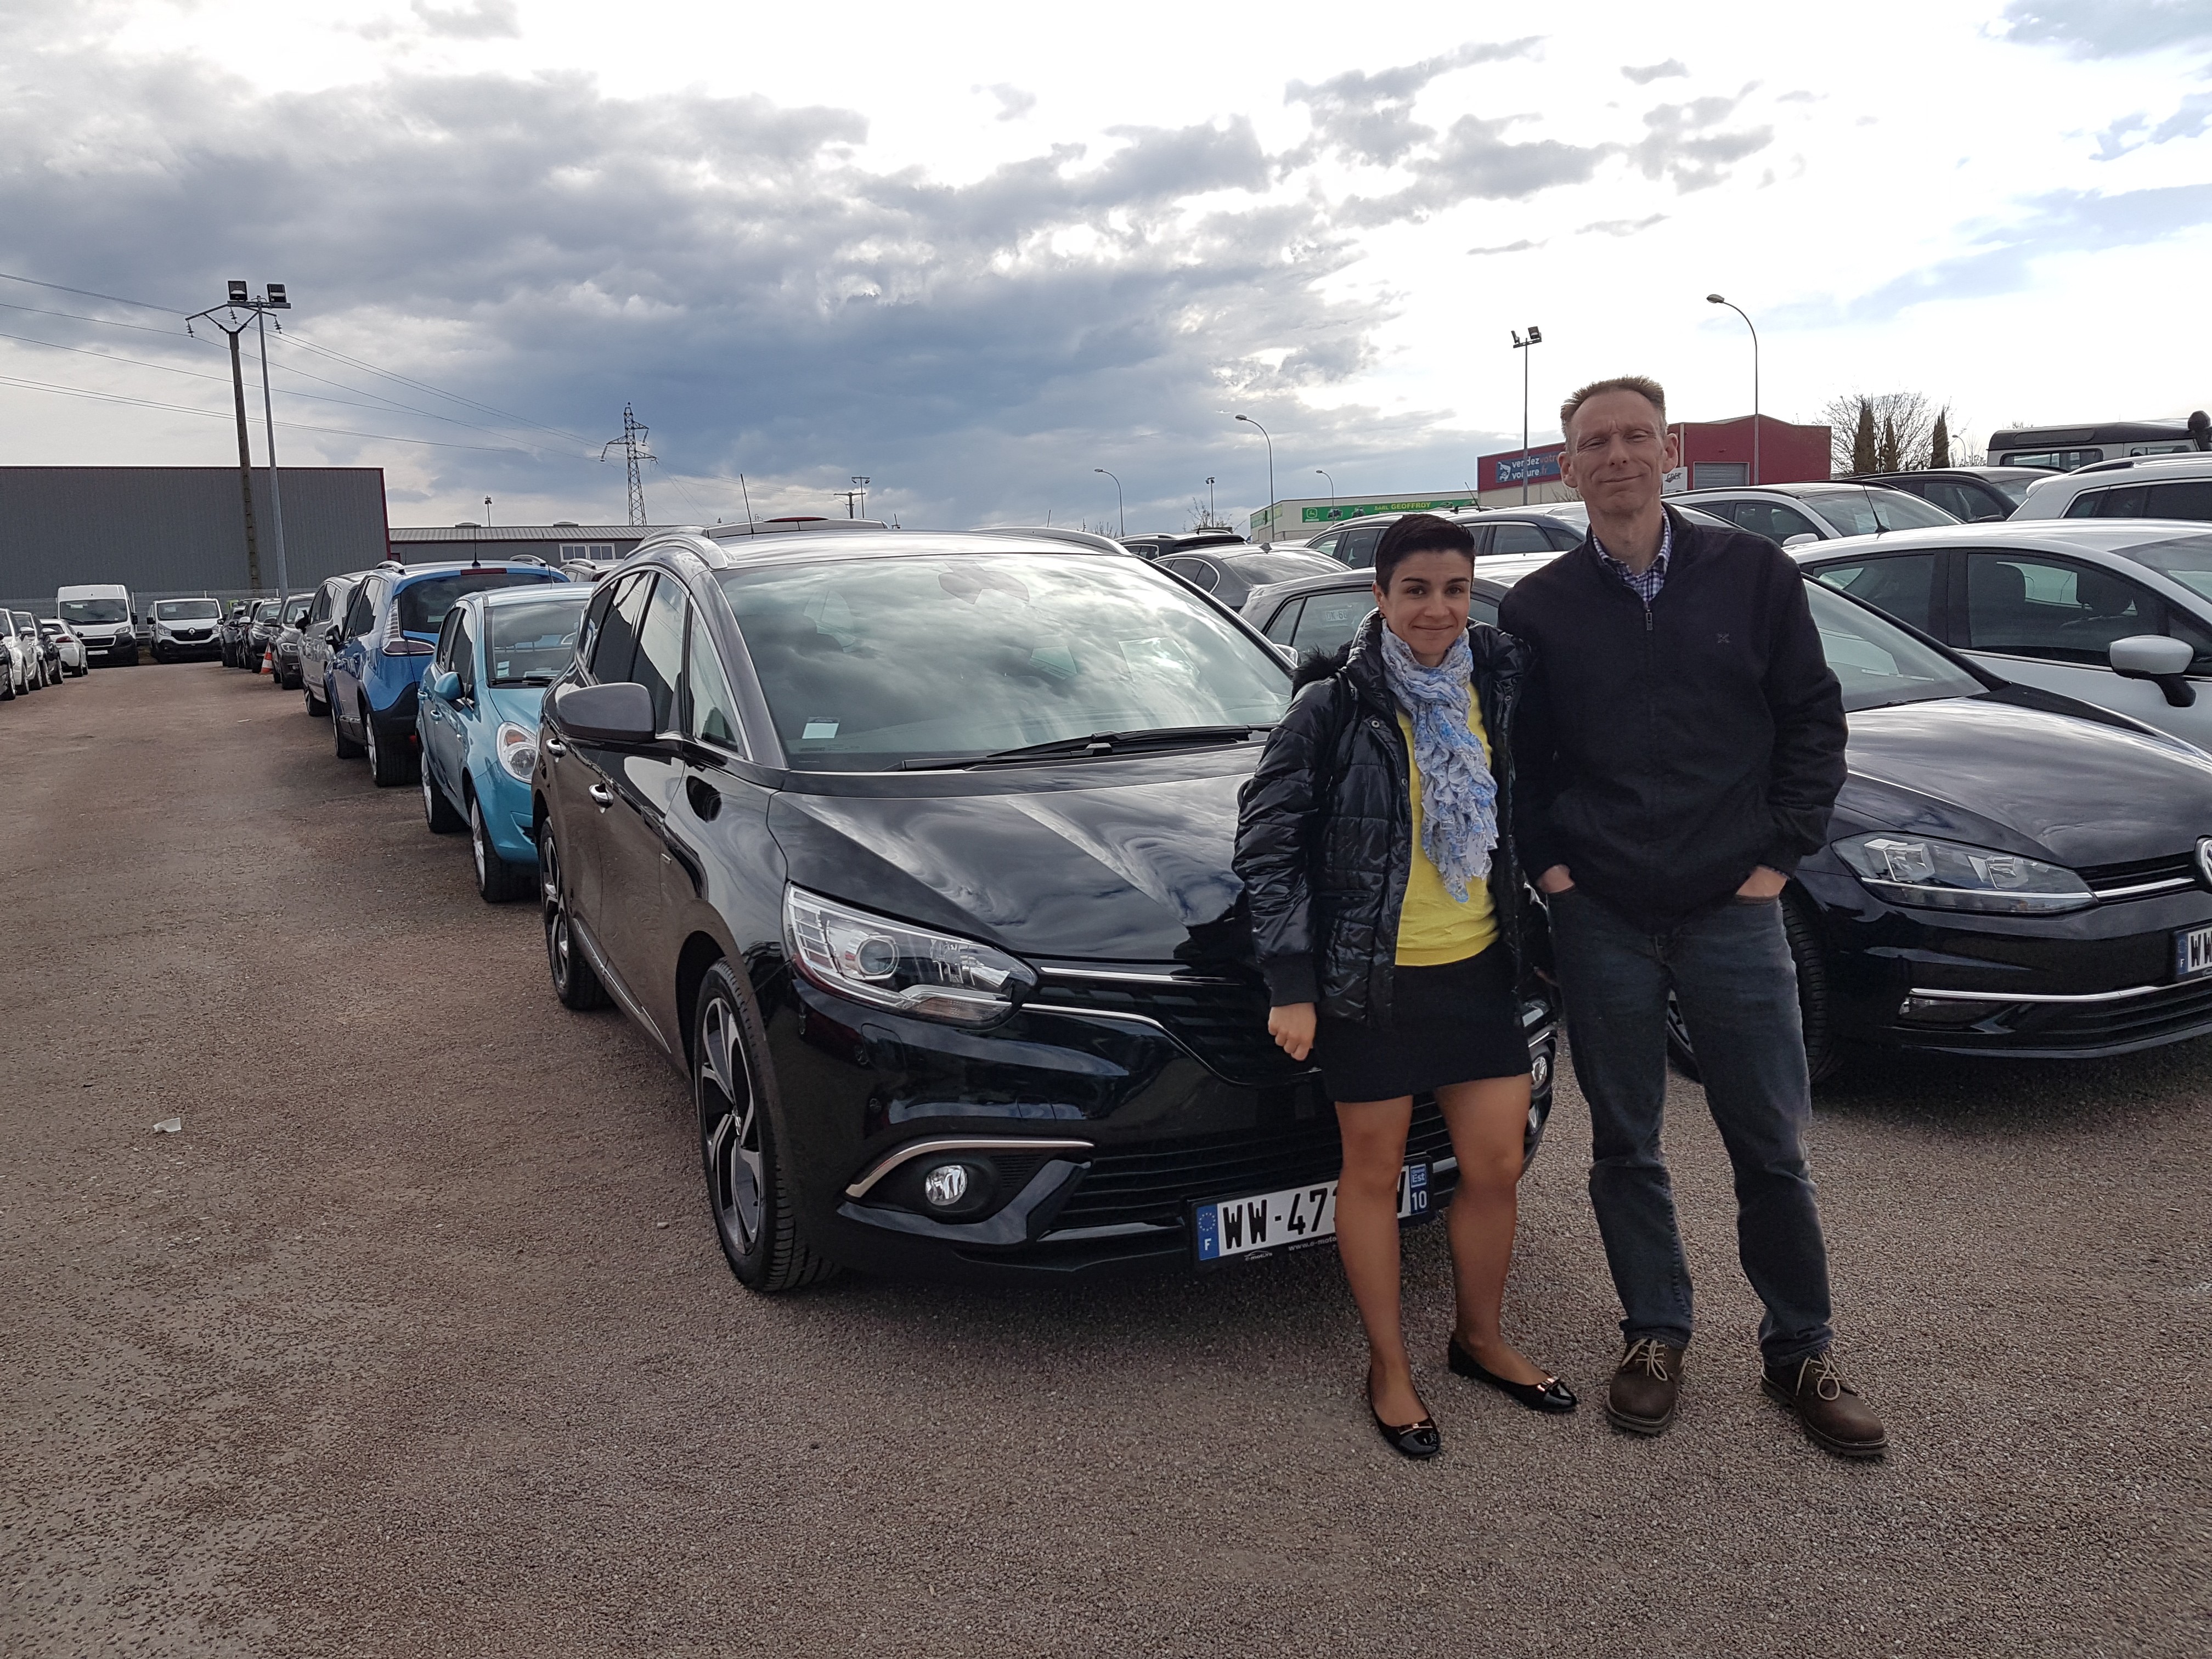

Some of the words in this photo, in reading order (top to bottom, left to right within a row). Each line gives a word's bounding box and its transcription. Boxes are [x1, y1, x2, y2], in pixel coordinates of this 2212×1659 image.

[2180, 958, 2185, 968] F
[1412, 1173, 1425, 1183] Est
[1412, 1190, 1427, 1210] 10
[1222, 1187, 1338, 1250] WW-47
[1204, 1238, 1212, 1251] F
